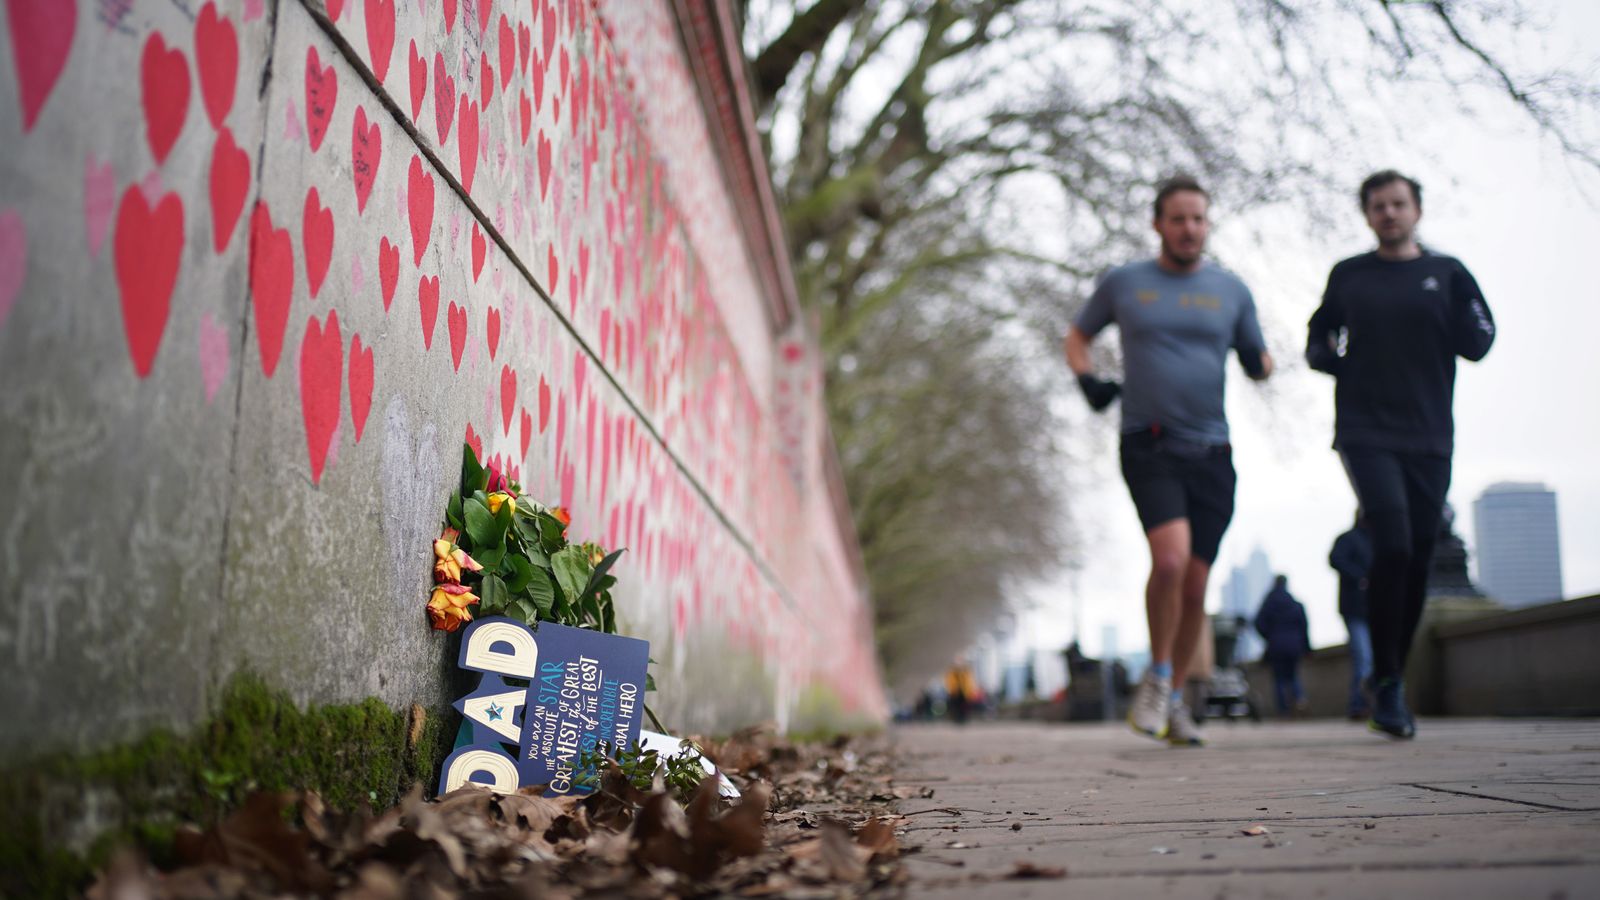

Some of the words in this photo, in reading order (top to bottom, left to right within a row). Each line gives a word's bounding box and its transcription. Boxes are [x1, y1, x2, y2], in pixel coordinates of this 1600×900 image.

[538, 661, 564, 704] STAR
[619, 683, 637, 718] HERO
[445, 622, 538, 795] DAD
[535, 705, 545, 719] AN
[579, 713, 599, 730] of
[587, 696, 598, 713] THE
[600, 679, 619, 739] INCREDIBLE
[533, 721, 543, 740] are
[542, 711, 559, 756] ABSOLUTE
[546, 758, 555, 770] THE
[559, 700, 570, 712] OF
[569, 701, 581, 718] the
